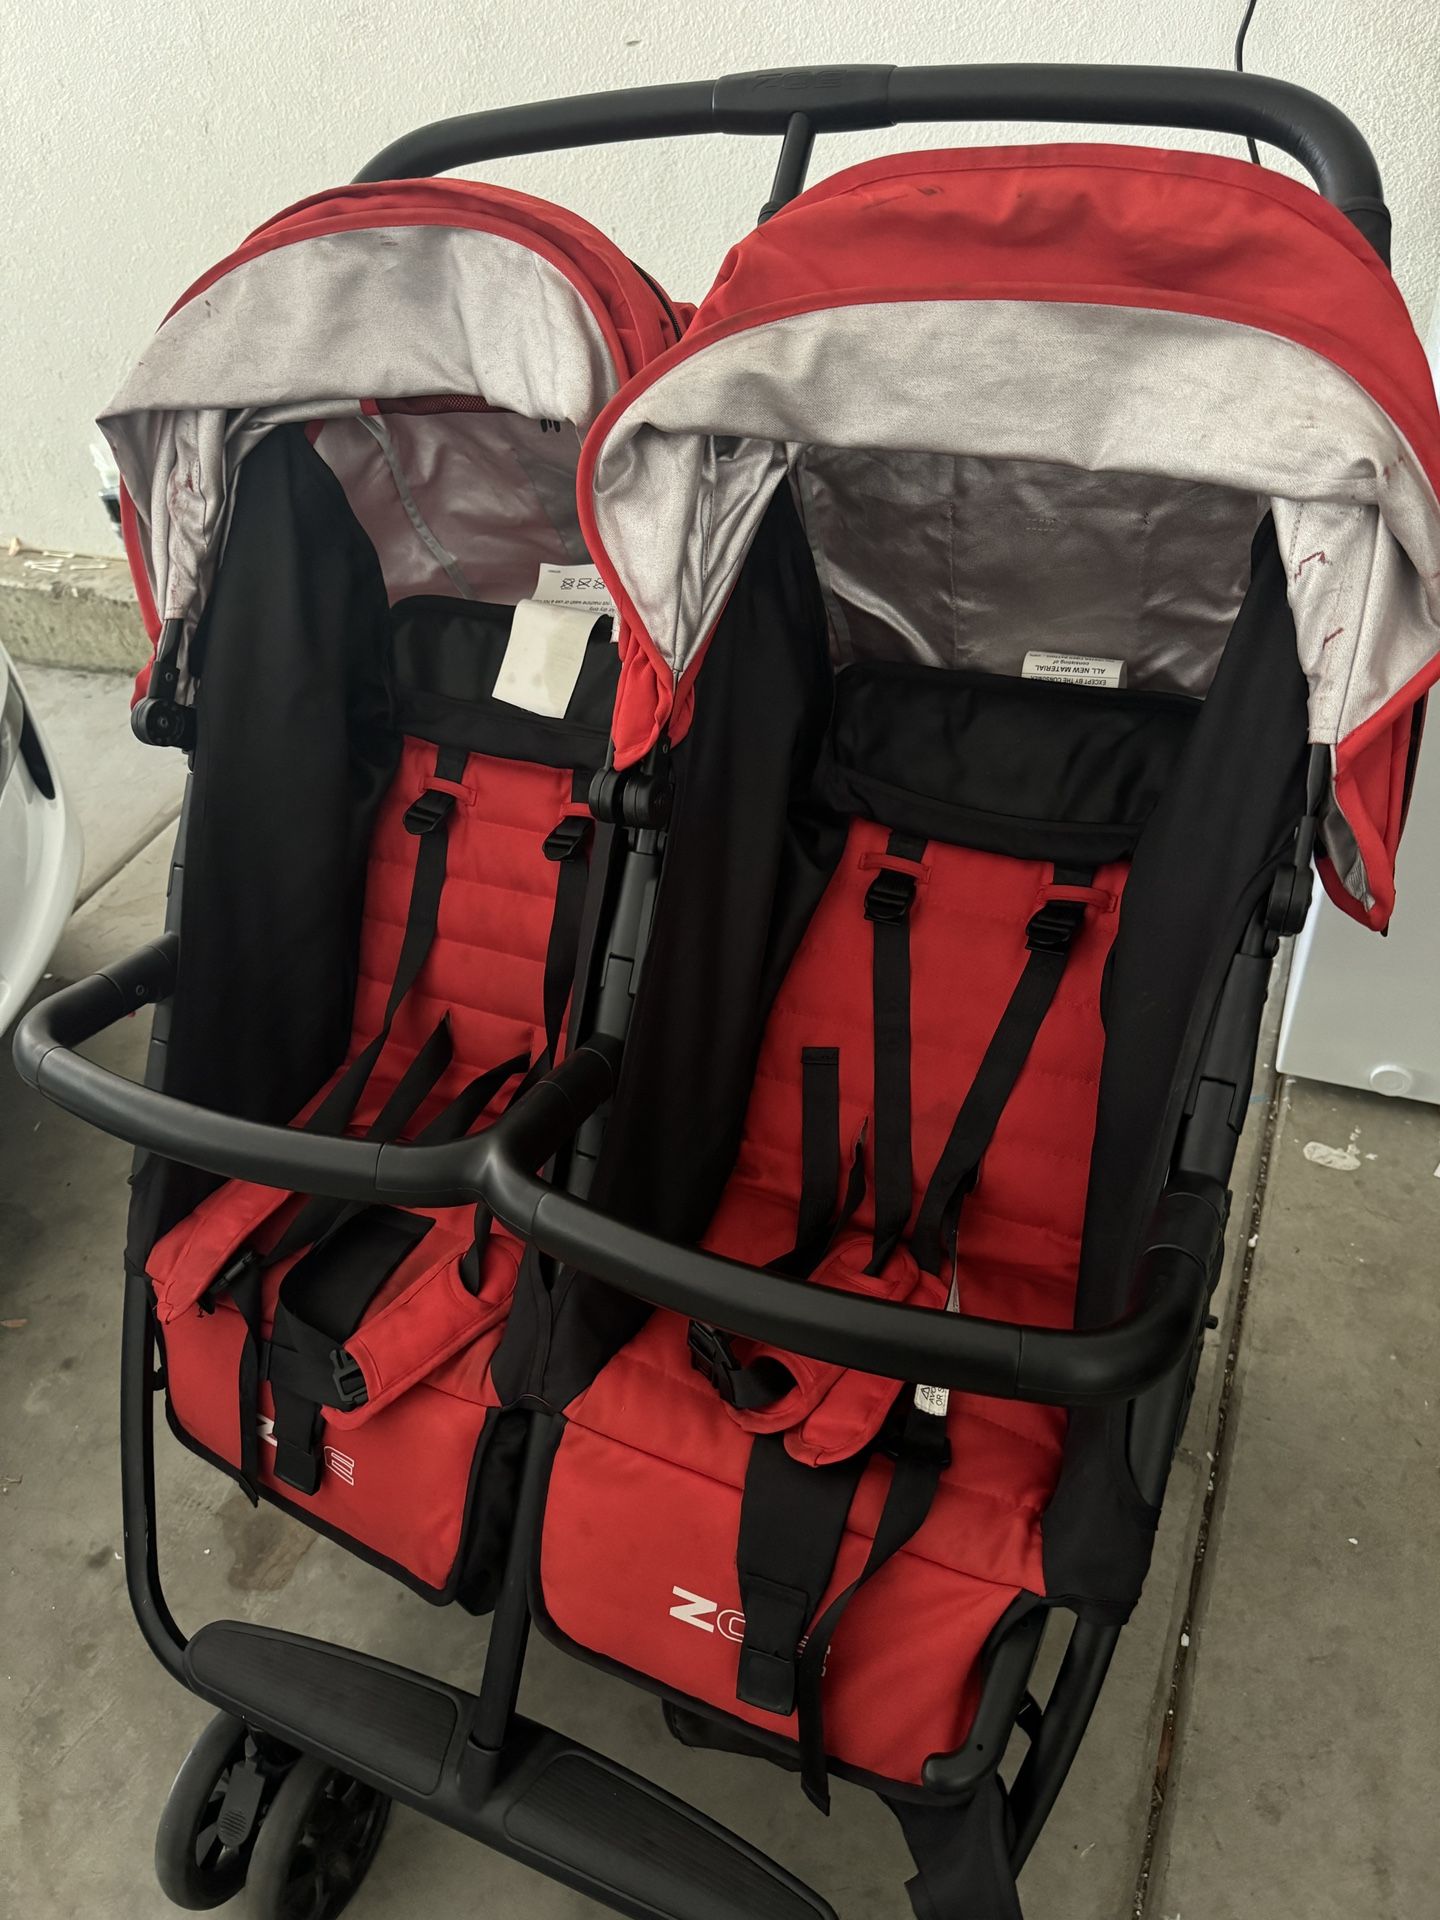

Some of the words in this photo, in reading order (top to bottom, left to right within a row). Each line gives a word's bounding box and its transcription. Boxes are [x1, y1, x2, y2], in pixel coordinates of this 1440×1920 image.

[1035, 664, 1072, 673] MATERIAL
[1073, 666, 1090, 674] NEW
[1092, 667, 1106, 675] ALL
[1084, 678, 1107, 686] EXCEPT
